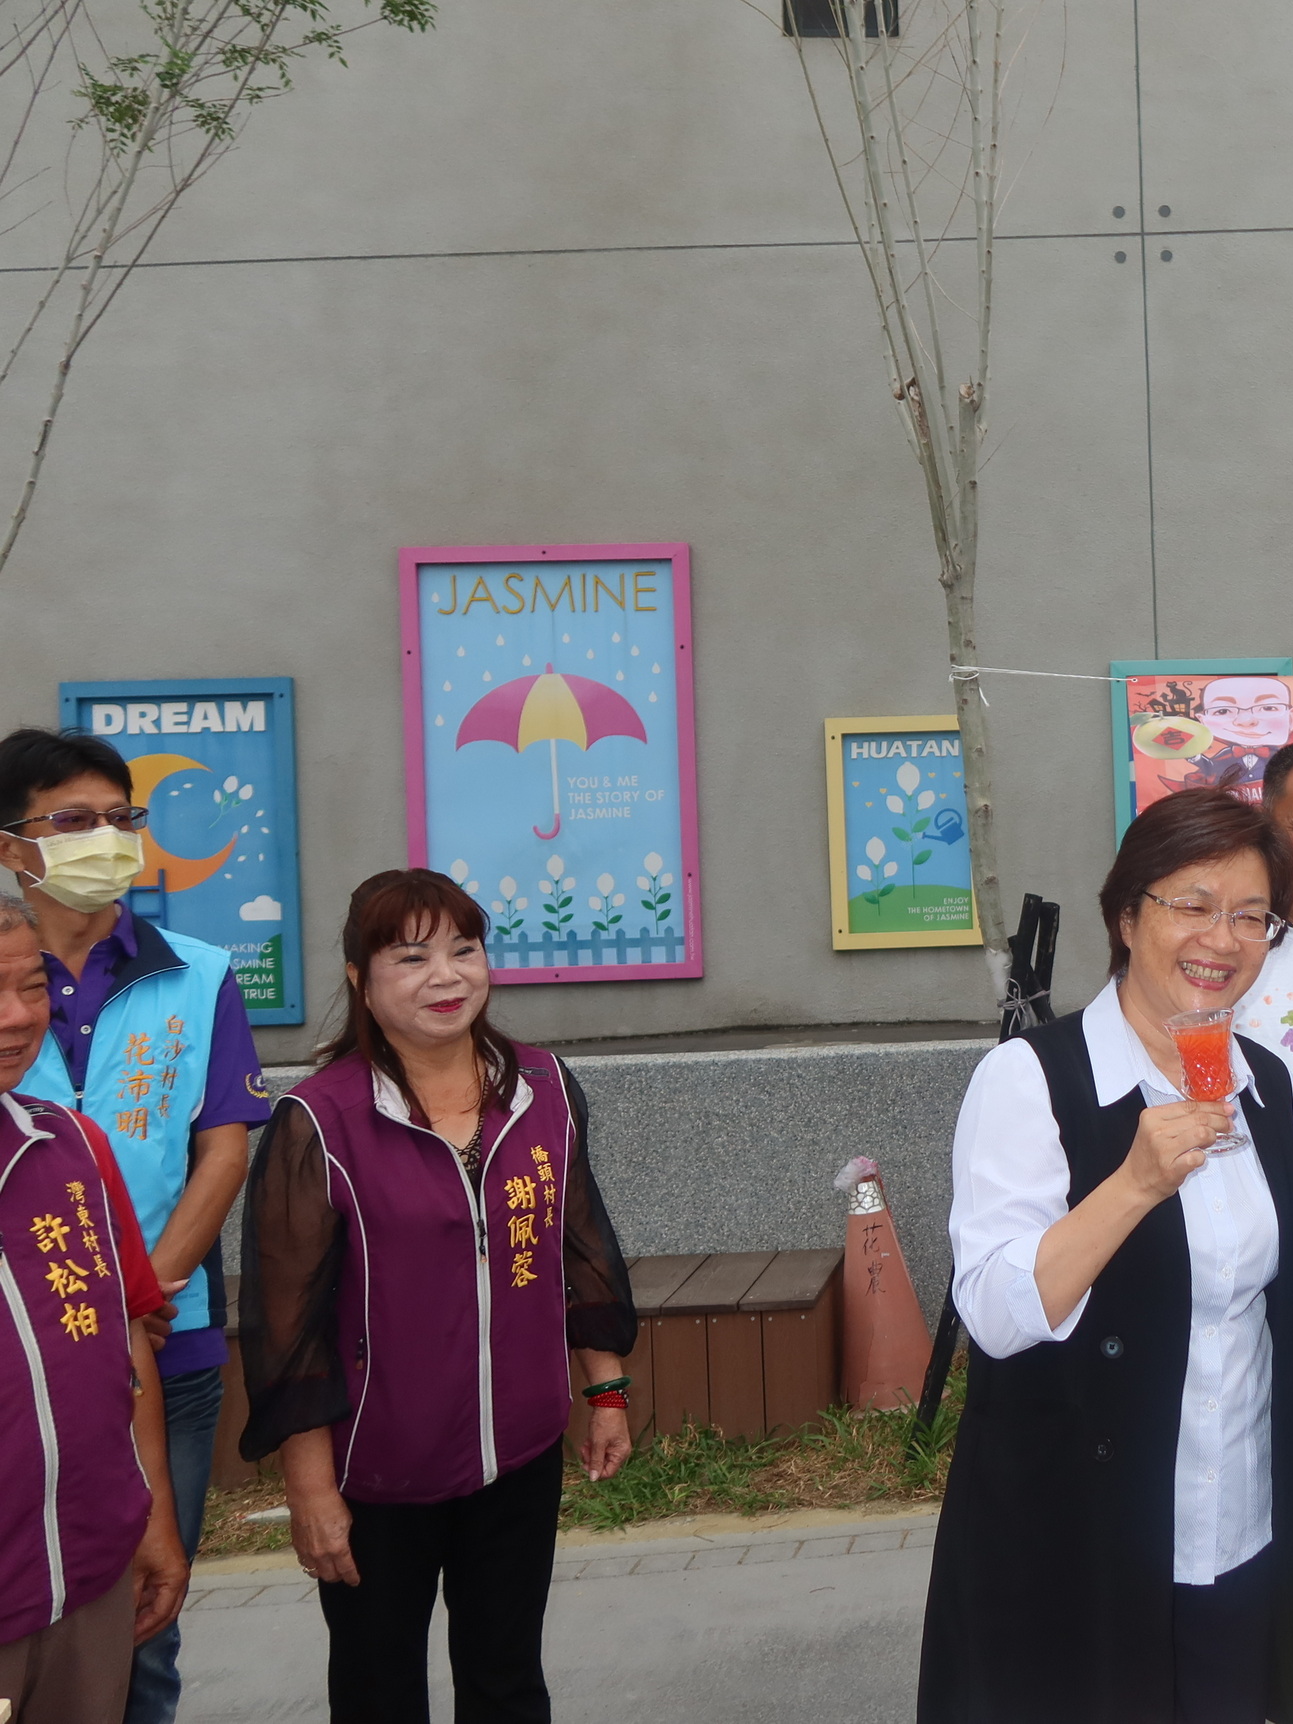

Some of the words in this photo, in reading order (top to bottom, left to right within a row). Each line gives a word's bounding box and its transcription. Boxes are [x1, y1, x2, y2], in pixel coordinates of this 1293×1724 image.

[437, 572, 657, 614] JASMINE
[92, 701, 266, 735] DREAM
[851, 739, 960, 759] HUATAN
[567, 777, 598, 788] YOU
[603, 776, 612, 788] &
[617, 775, 638, 786] ME
[568, 792, 592, 804] THE
[596, 791, 640, 804] STORY
[645, 790, 665, 801] OF
[569, 807, 631, 820] JASMINE
[922, 905, 969, 913] HOMETOWN
[936, 913, 969, 921] JASMINE
[230, 957, 275, 969] SMINE
[236, 973, 275, 985] REAM
[243, 988, 276, 999] TRUE
[157, 1014, 185, 1118] 白沙村長
[116, 1032, 154, 1141] 花沛明
[530, 1145, 557, 1228] 橋頭村長
[65, 1180, 111, 1278] 灣東村長
[504, 1175, 539, 1288] 謝佩蓉
[29, 1213, 98, 1342] 許松柏
